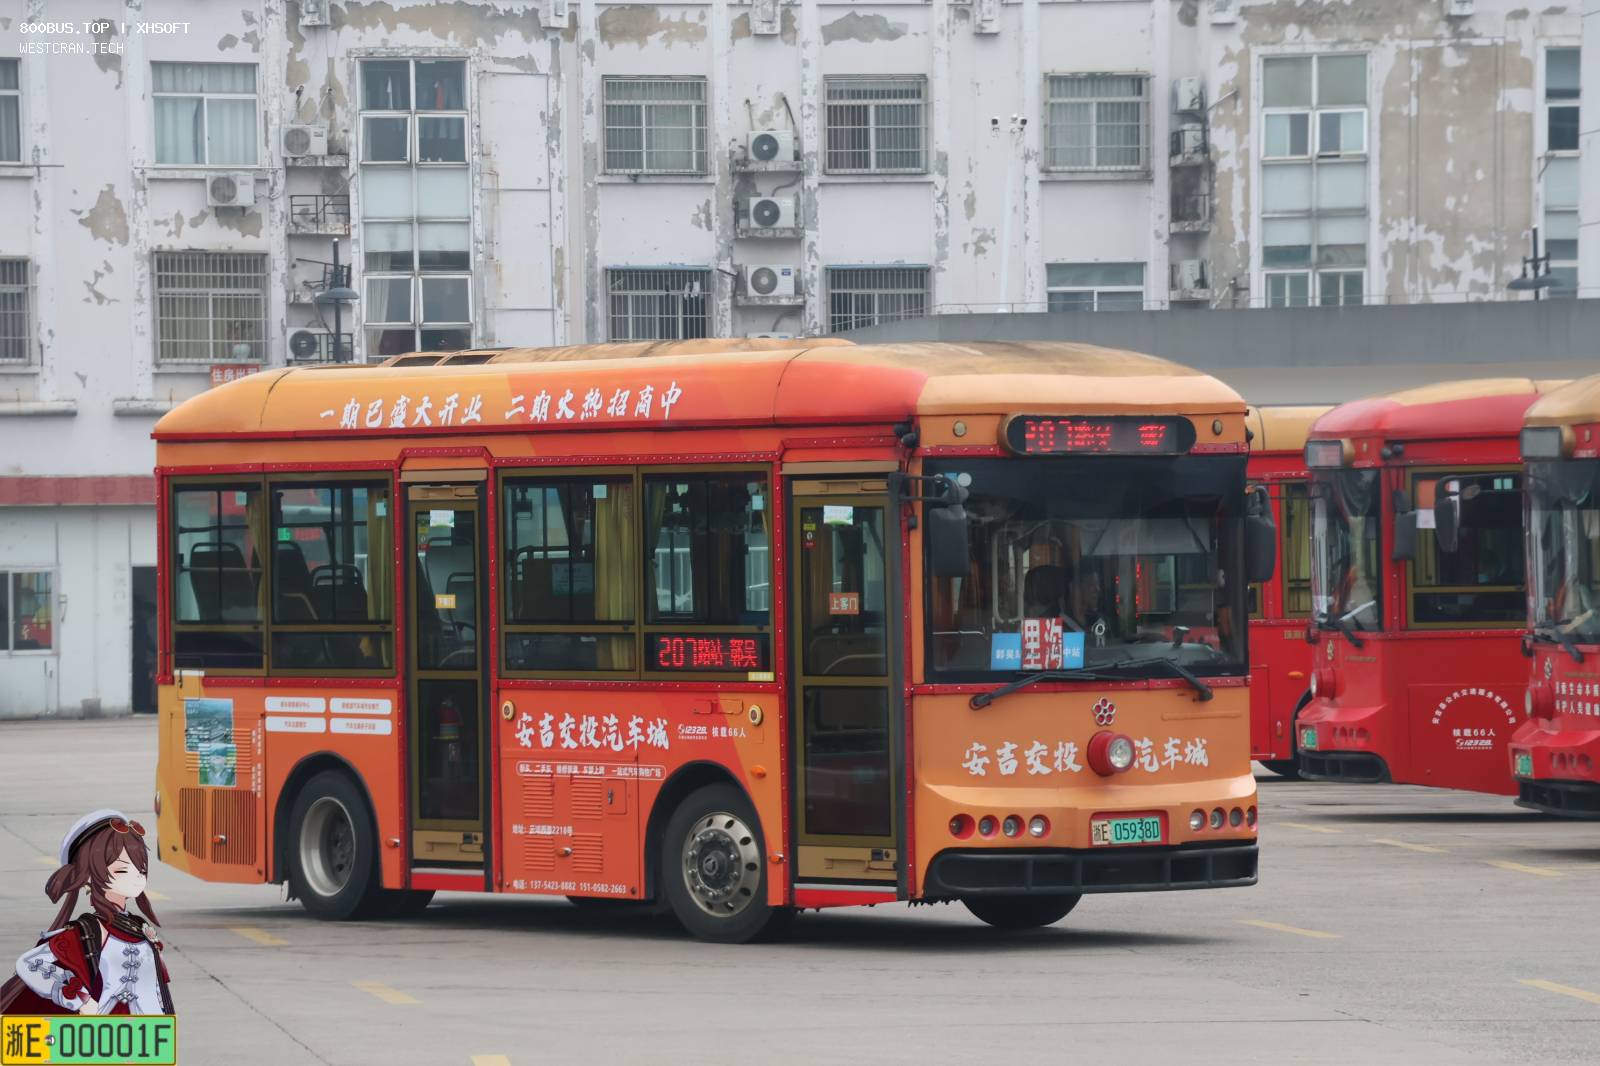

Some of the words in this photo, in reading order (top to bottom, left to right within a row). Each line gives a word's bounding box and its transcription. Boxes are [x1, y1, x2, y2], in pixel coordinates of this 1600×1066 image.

[319, 393, 483, 430] 一期已盛大开业
[504, 381, 682, 425] 二期火热招商中
[515, 712, 669, 752] 安吉交投汽车城
[962, 741, 1083, 777] 安吉交投
[1132, 736, 1209, 773] 汽车城
[1114, 820, 1160, 841] 05938D
